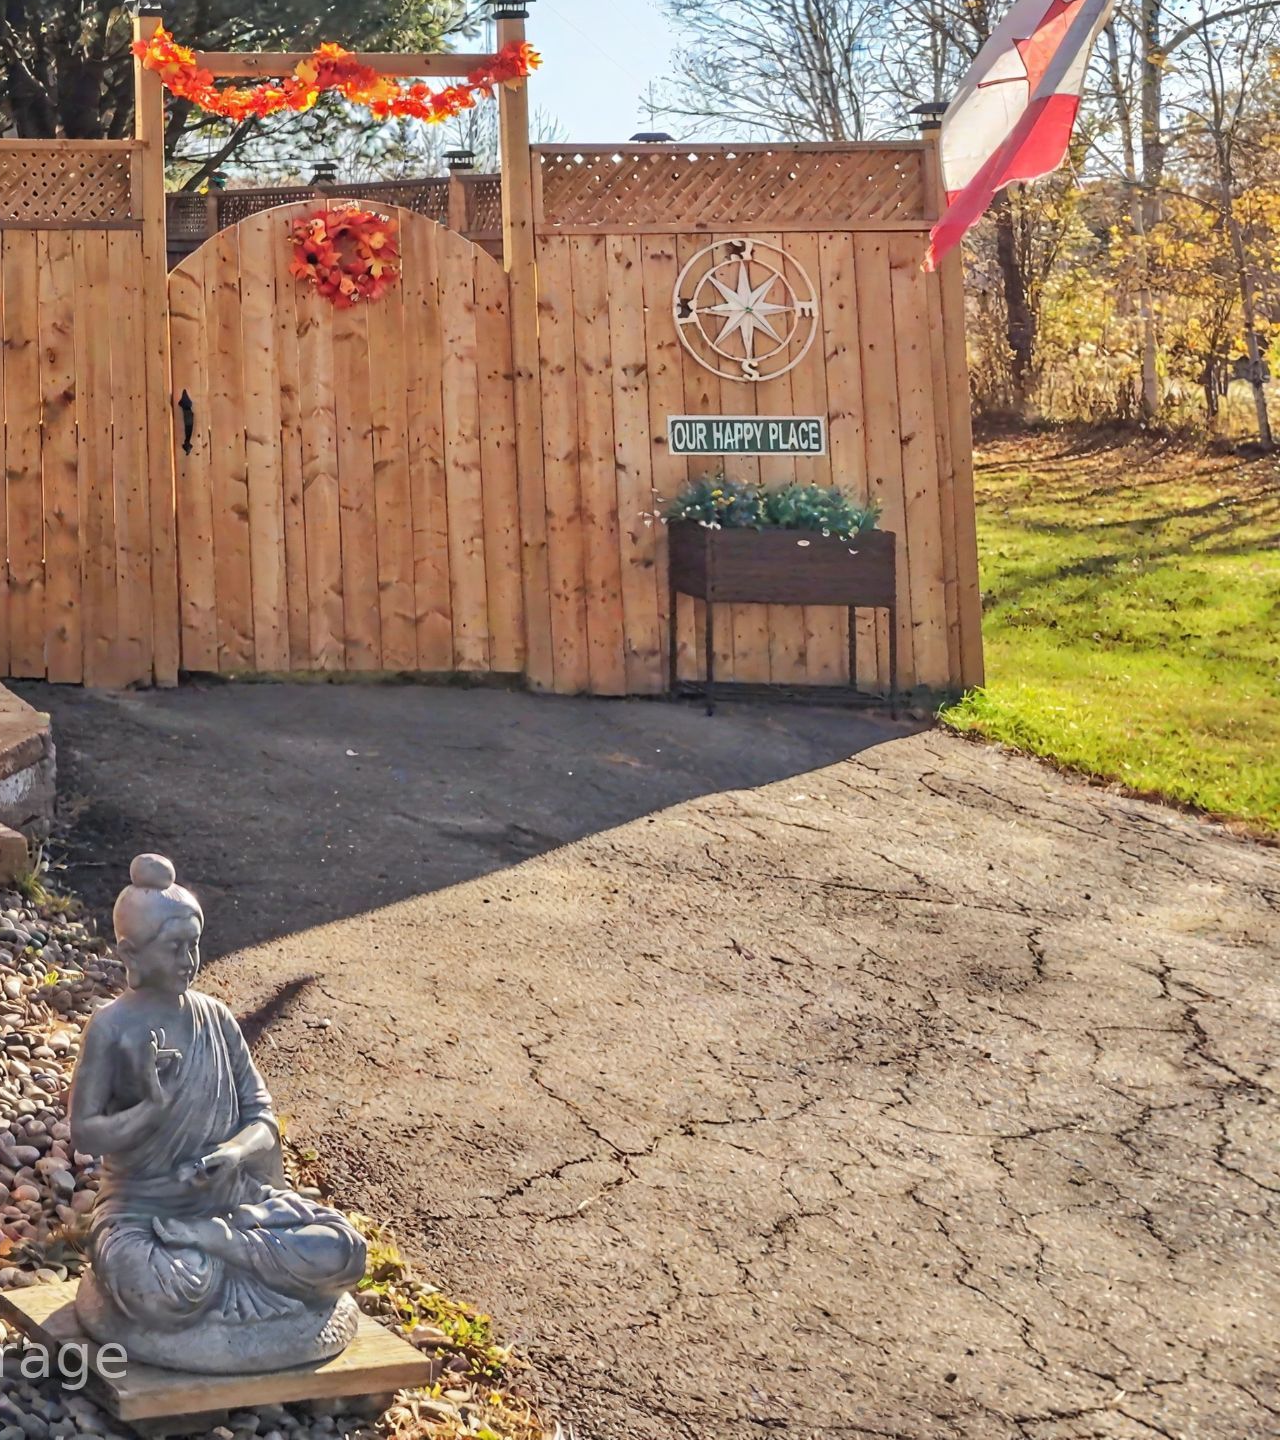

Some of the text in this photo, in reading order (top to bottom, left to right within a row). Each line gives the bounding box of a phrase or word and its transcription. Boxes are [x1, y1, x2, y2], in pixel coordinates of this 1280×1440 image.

[674, 422, 820, 450] OUR HAPPY PLACE
